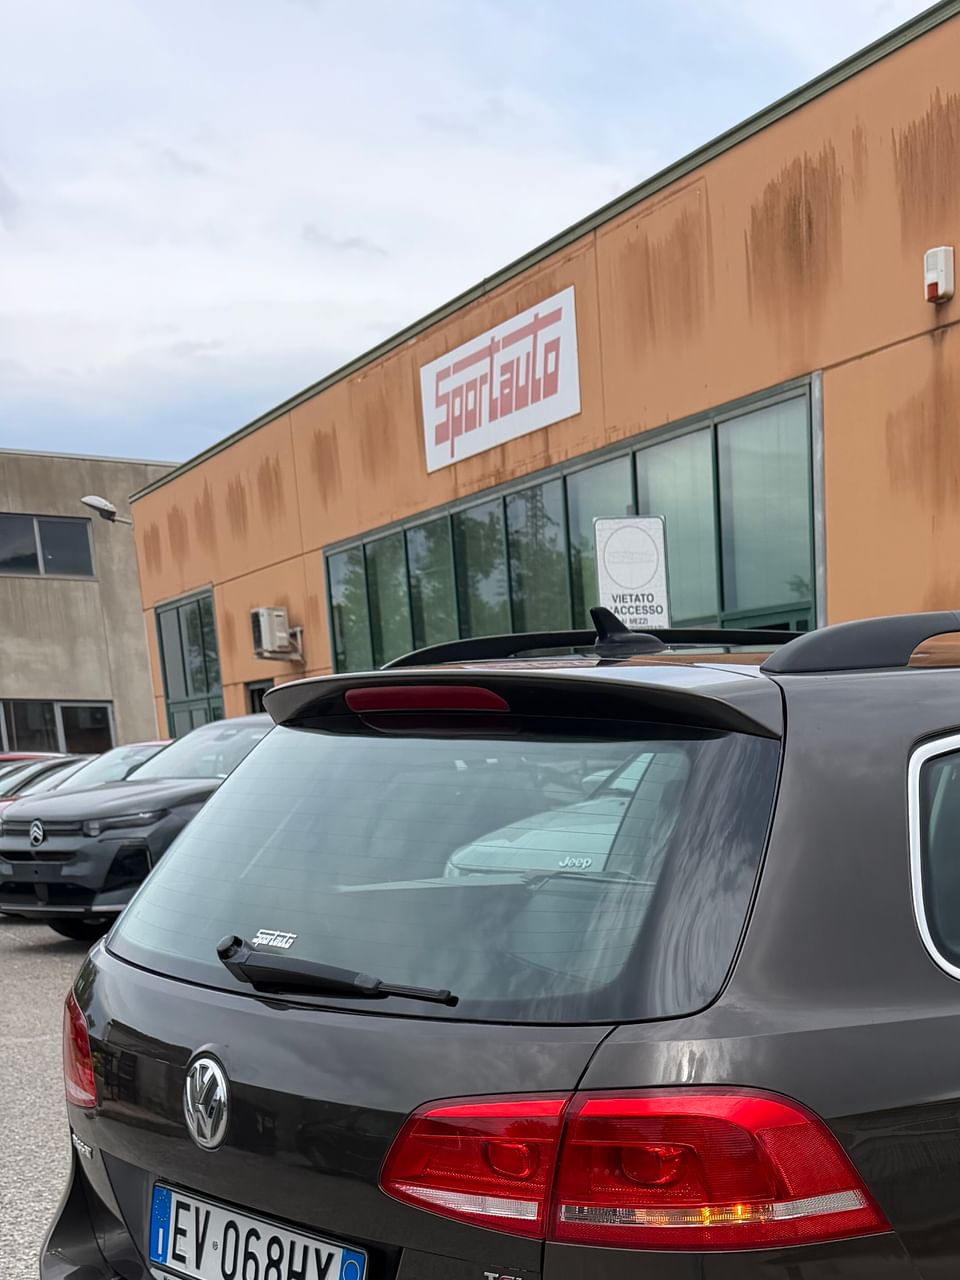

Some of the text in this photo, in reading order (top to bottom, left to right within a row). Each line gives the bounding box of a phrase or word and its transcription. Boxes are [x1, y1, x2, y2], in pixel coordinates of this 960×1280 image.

[435, 307, 563, 458] Sportauto
[611, 593, 655, 604] VIETATO
[610, 604, 664, 616] 'ACCESSO
[559, 856, 592, 869] Jeep
[252, 928, 298, 948] Sportauto
